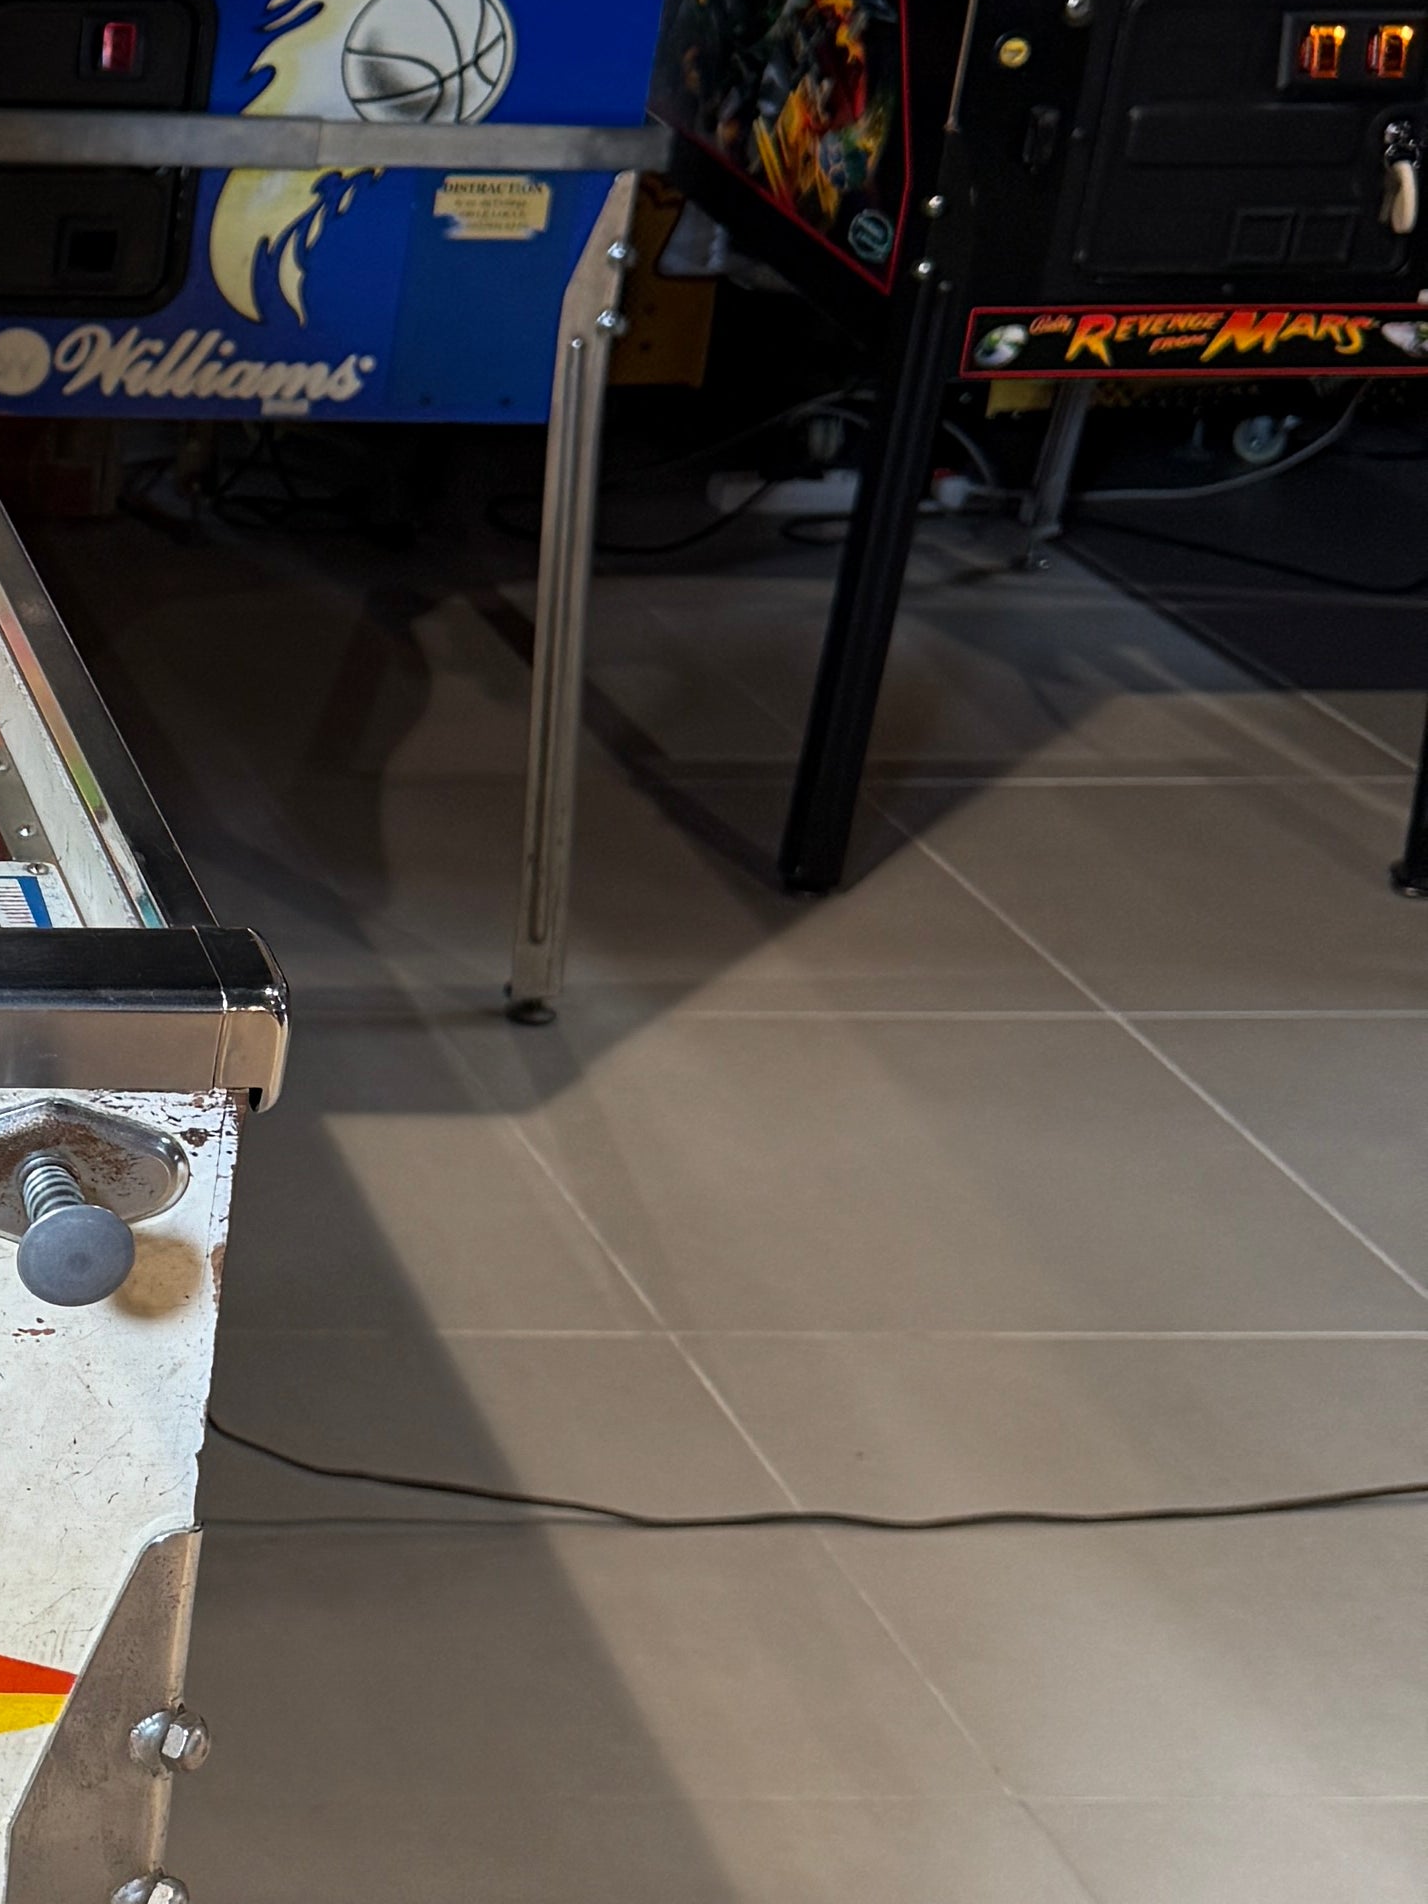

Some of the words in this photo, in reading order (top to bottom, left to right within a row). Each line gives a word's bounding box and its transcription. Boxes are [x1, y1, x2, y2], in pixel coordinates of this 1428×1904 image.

[54, 325, 362, 400] Williams
[1065, 311, 1225, 366] REVENGE
[1199, 310, 1374, 363] MARS
[1148, 334, 1209, 355] FROM
